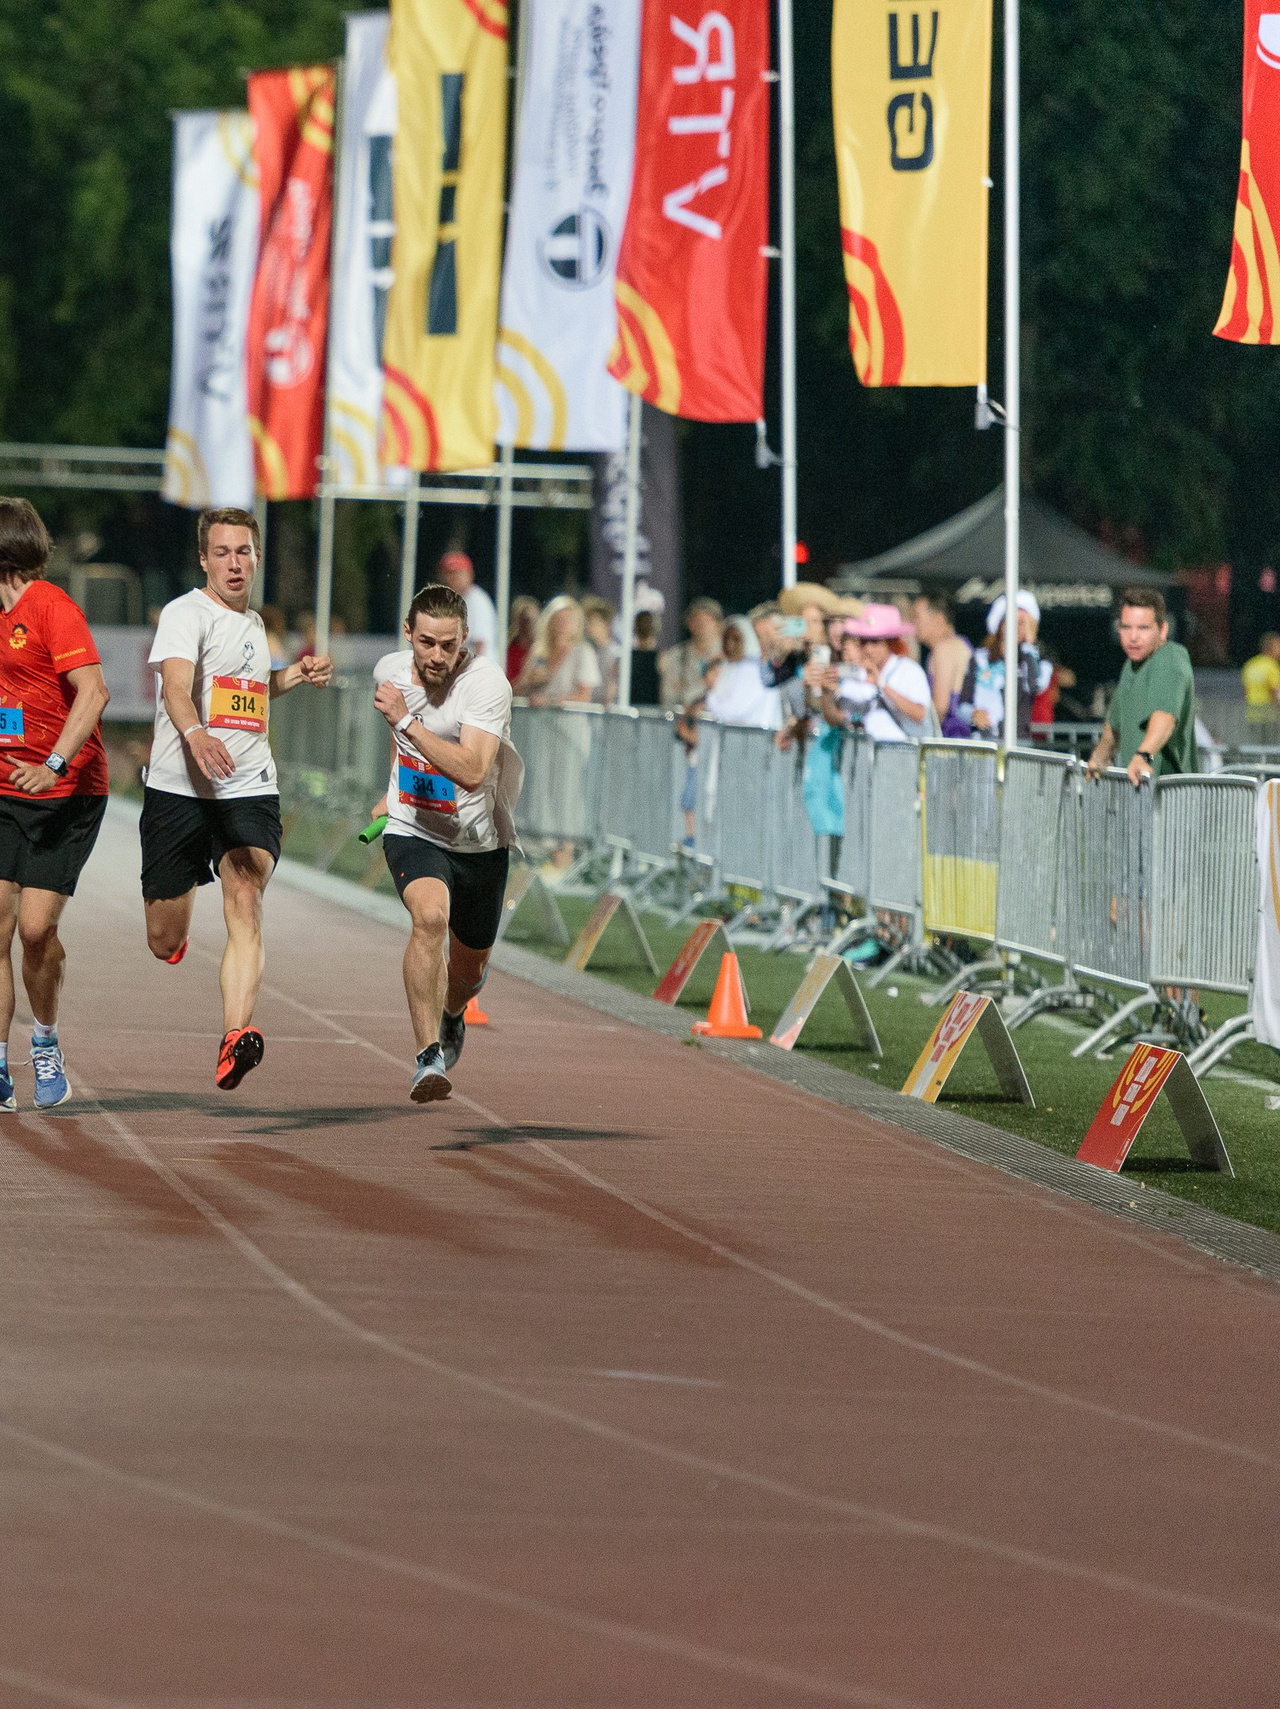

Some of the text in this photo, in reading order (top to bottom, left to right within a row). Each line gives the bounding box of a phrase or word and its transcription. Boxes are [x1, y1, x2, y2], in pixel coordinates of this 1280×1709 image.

[231, 694, 265, 716] 314 2
[12, 721, 18, 731] 3
[412, 775, 448, 797] 314 3
